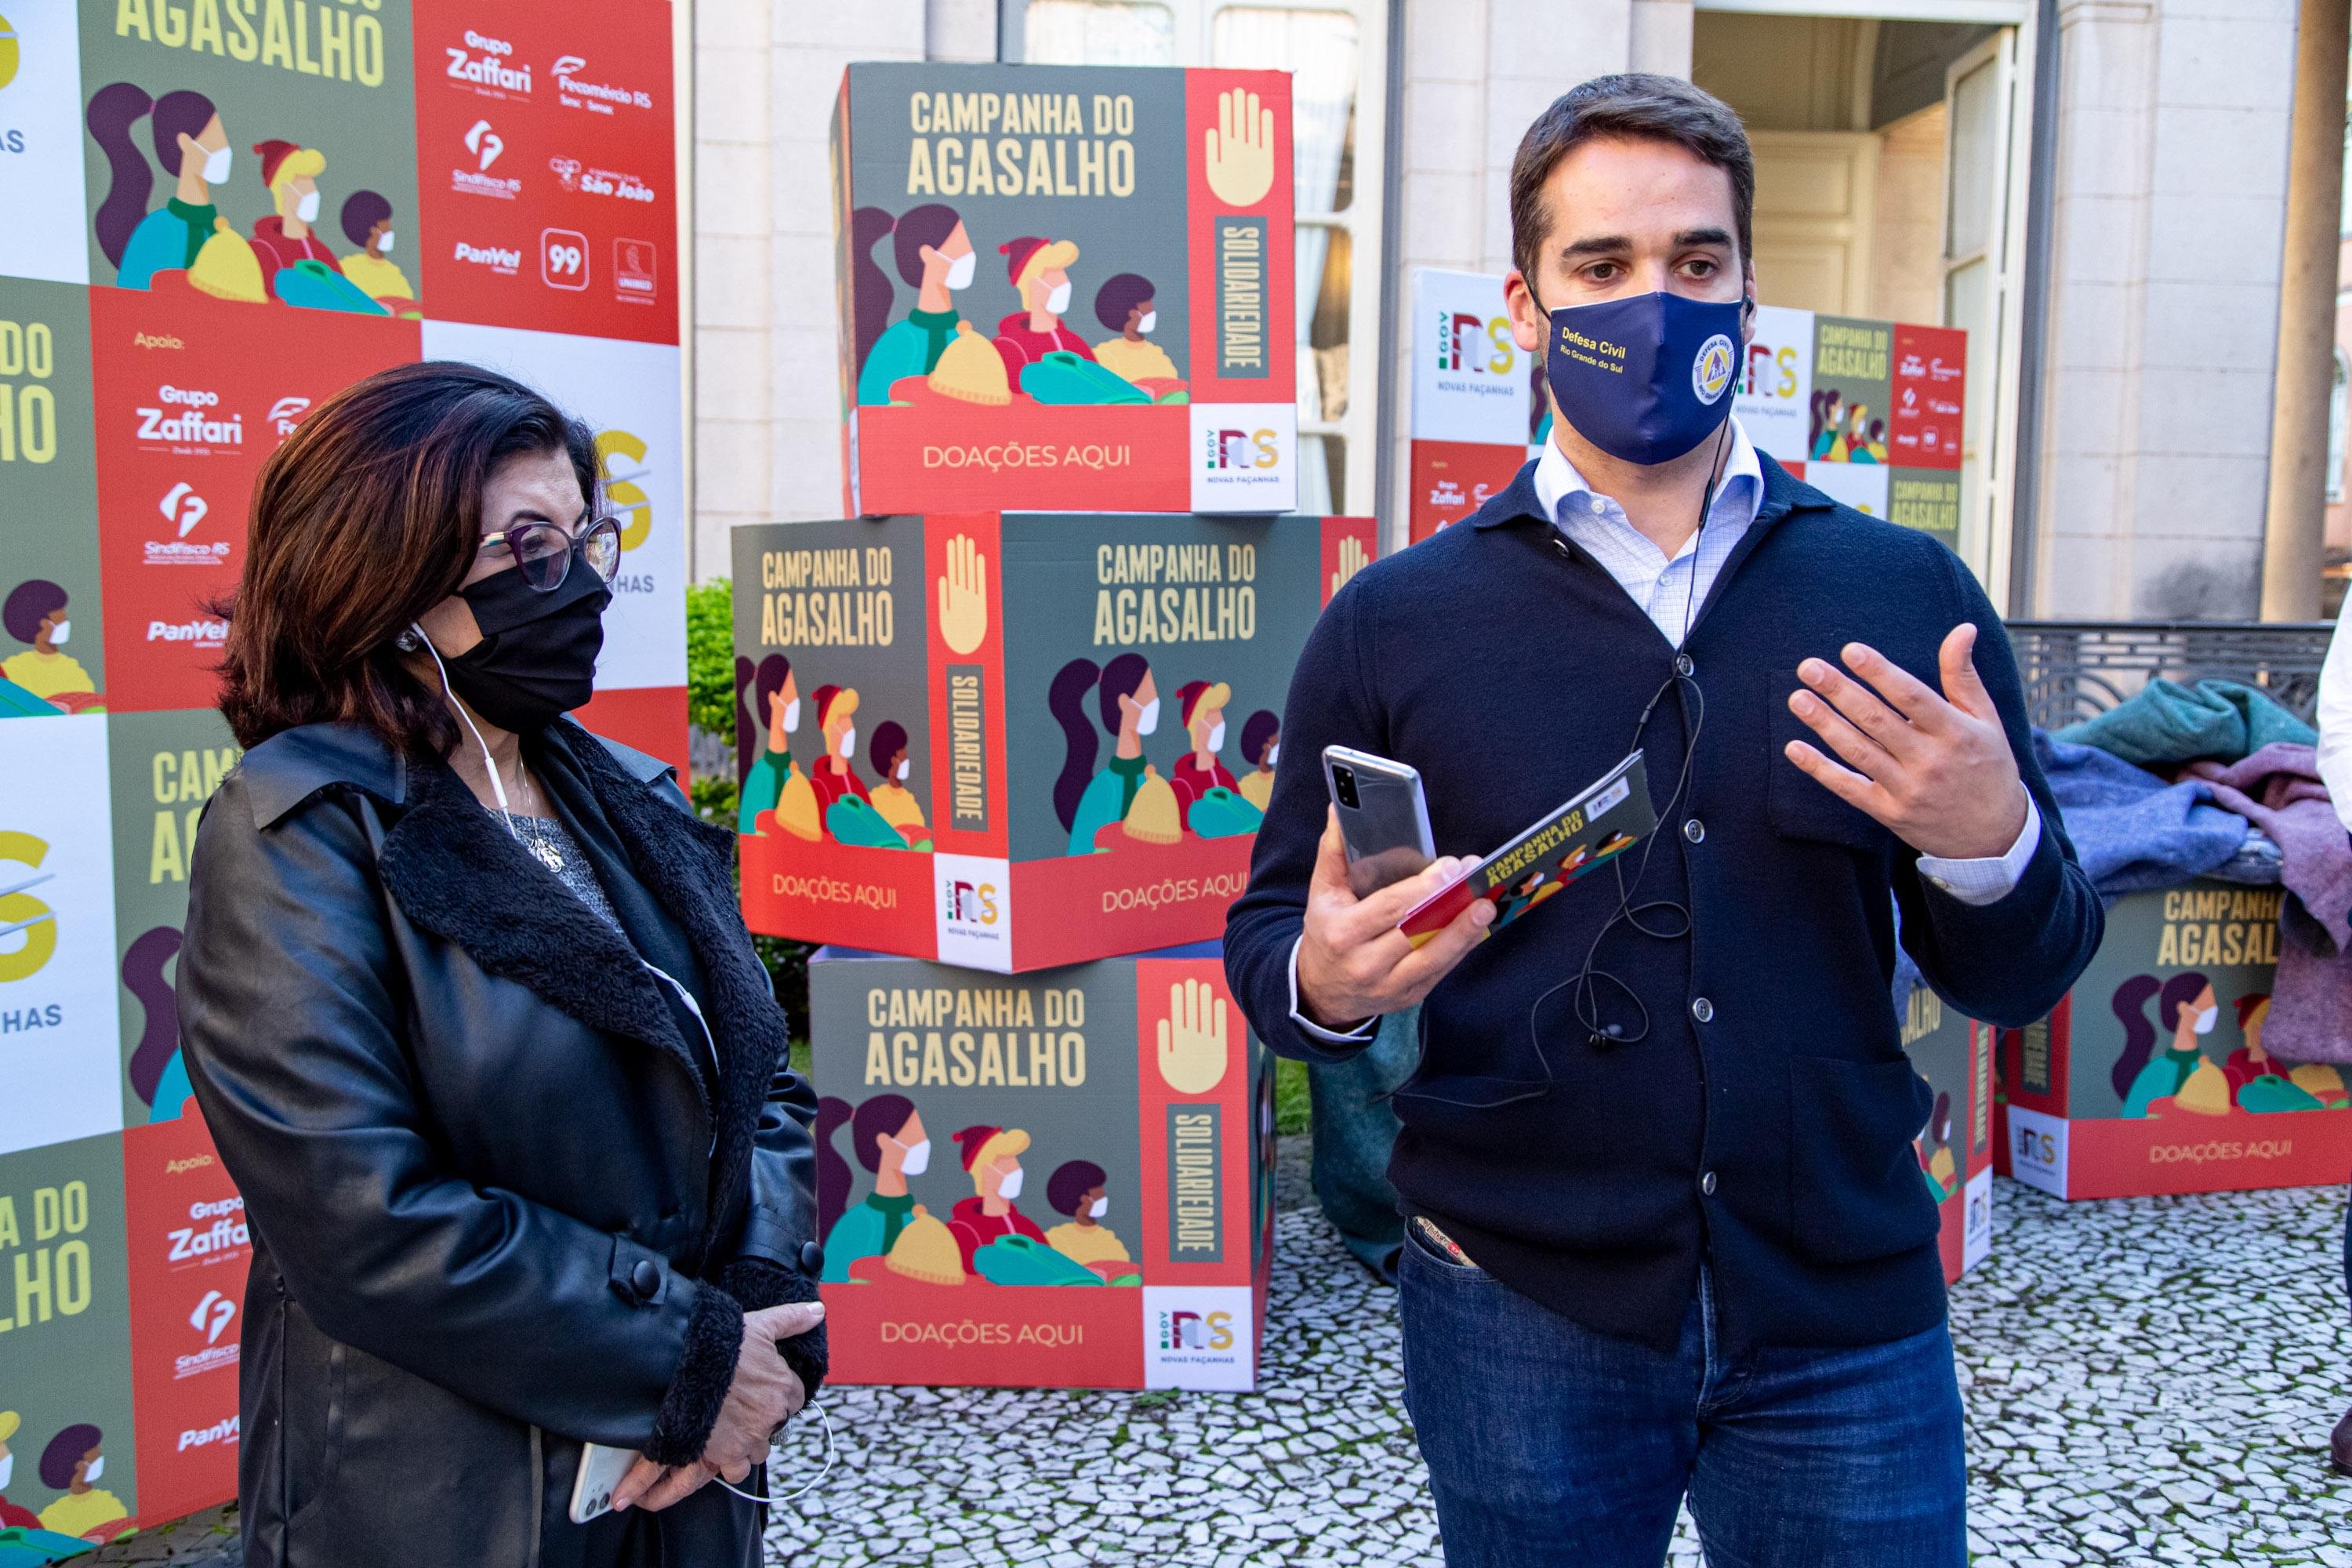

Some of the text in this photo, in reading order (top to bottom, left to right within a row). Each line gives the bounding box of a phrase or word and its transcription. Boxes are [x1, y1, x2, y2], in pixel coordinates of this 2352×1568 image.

[116, 0, 384, 87] AGASALHO
[464, 30, 513, 56] Grupo
[446, 47, 532, 93] Zaffari
[909, 91, 1134, 136] CAMPANHA DO
[906, 138, 1135, 198] AGASALHO
[580, 173, 613, 196] São
[615, 180, 655, 203] João
[454, 241, 521, 268] PanVel
[549, 244, 581, 275] 99
[1223, 226, 1261, 368] SOLIDARIEDADE
[1560, 344, 1624, 374] Rio Grande do Sul
[1563, 326, 1626, 359] Defesa Civil
[159, 384, 220, 408] Grupo
[136, 407, 242, 445] Zaffari
[923, 441, 1131, 473] DOAÇÕES AQUI
[144, 541, 230, 555] Sindifisco RS
[1098, 544, 1255, 584] CAMPANHA DO
[761, 546, 892, 590] CAMPANHA DO
[147, 621, 229, 641] PanVel
[760, 590, 894, 646] AGASALHO
[1094, 586, 1255, 646] AGASALHO
[951, 675, 983, 821] SOLIDARIEDADE
[1486, 825, 1560, 877] CAMPANHA
[1489, 818, 1584, 888] AGASALHO
[772, 873, 897, 909] DOAÇÕES AQUI
[1102, 871, 1247, 913] DOAÇÕES AQUI
[2158, 922, 2279, 967] AGASAL
[867, 989, 1084, 1028] CAMPANHA DO
[865, 1032, 1086, 1087] AGASALHO
[2149, 1140, 2292, 1166] DOAÇÕES AQUI
[1176, 1114, 1214, 1253] SOLIDARIEDADE
[34, 1180, 89, 1241] DO
[190, 1196, 244, 1220] Grupo
[167, 1218, 251, 1262] Zaffa
[880, 1319, 1083, 1349] DOAÇÕES AQUI
[1160, 1311, 1169, 1338] GOV
[177, 1414, 240, 1452] PanV
